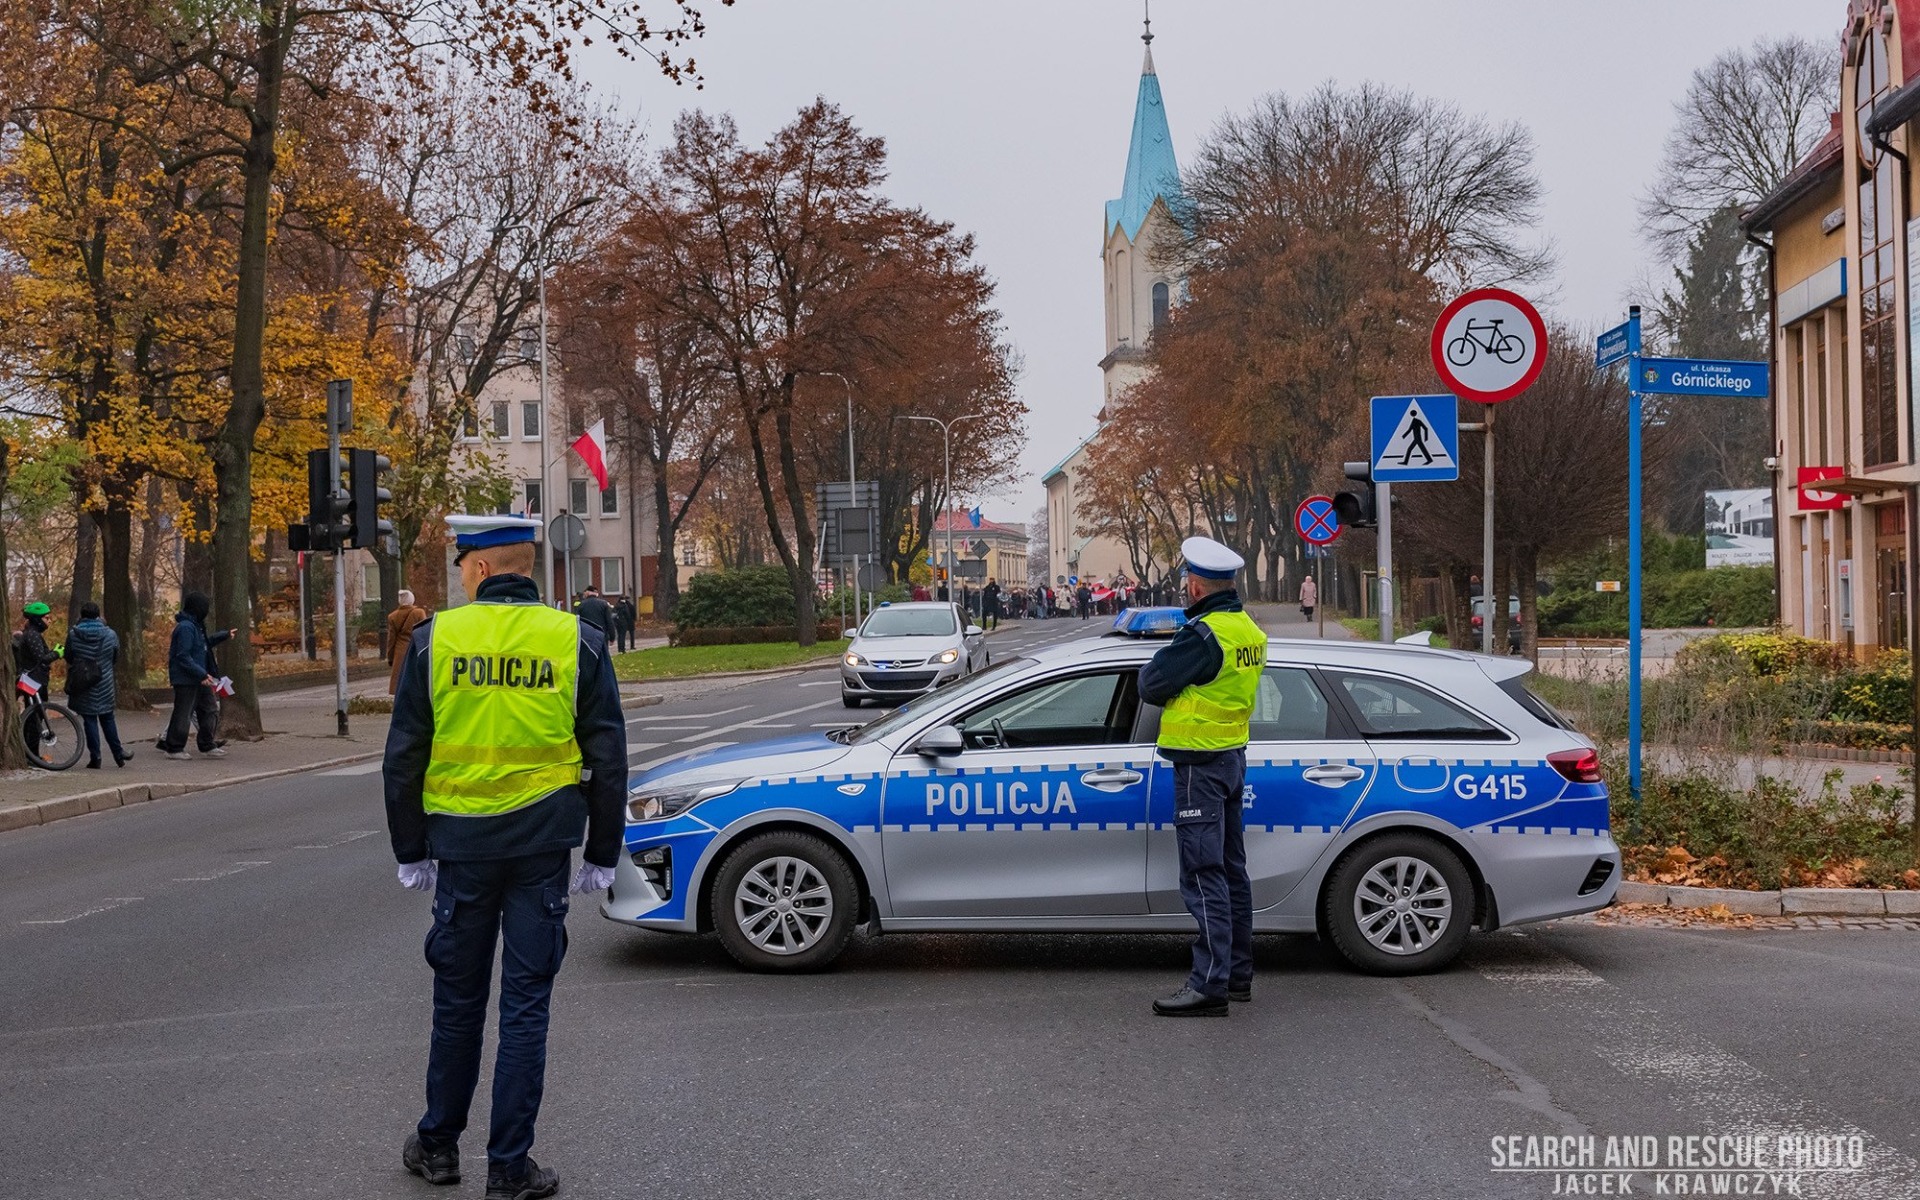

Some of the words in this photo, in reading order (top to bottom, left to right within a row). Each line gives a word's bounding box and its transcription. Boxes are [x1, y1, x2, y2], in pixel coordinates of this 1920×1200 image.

[1691, 364, 1700, 372] ul.
[1702, 364, 1732, 373] Łukasza
[1671, 372, 1751, 392] Górnickiego
[452, 656, 555, 688] POLICJA
[1453, 773, 1527, 800] G415
[926, 781, 1077, 816] POLICJA
[1178, 809, 1202, 818] POLICJA
